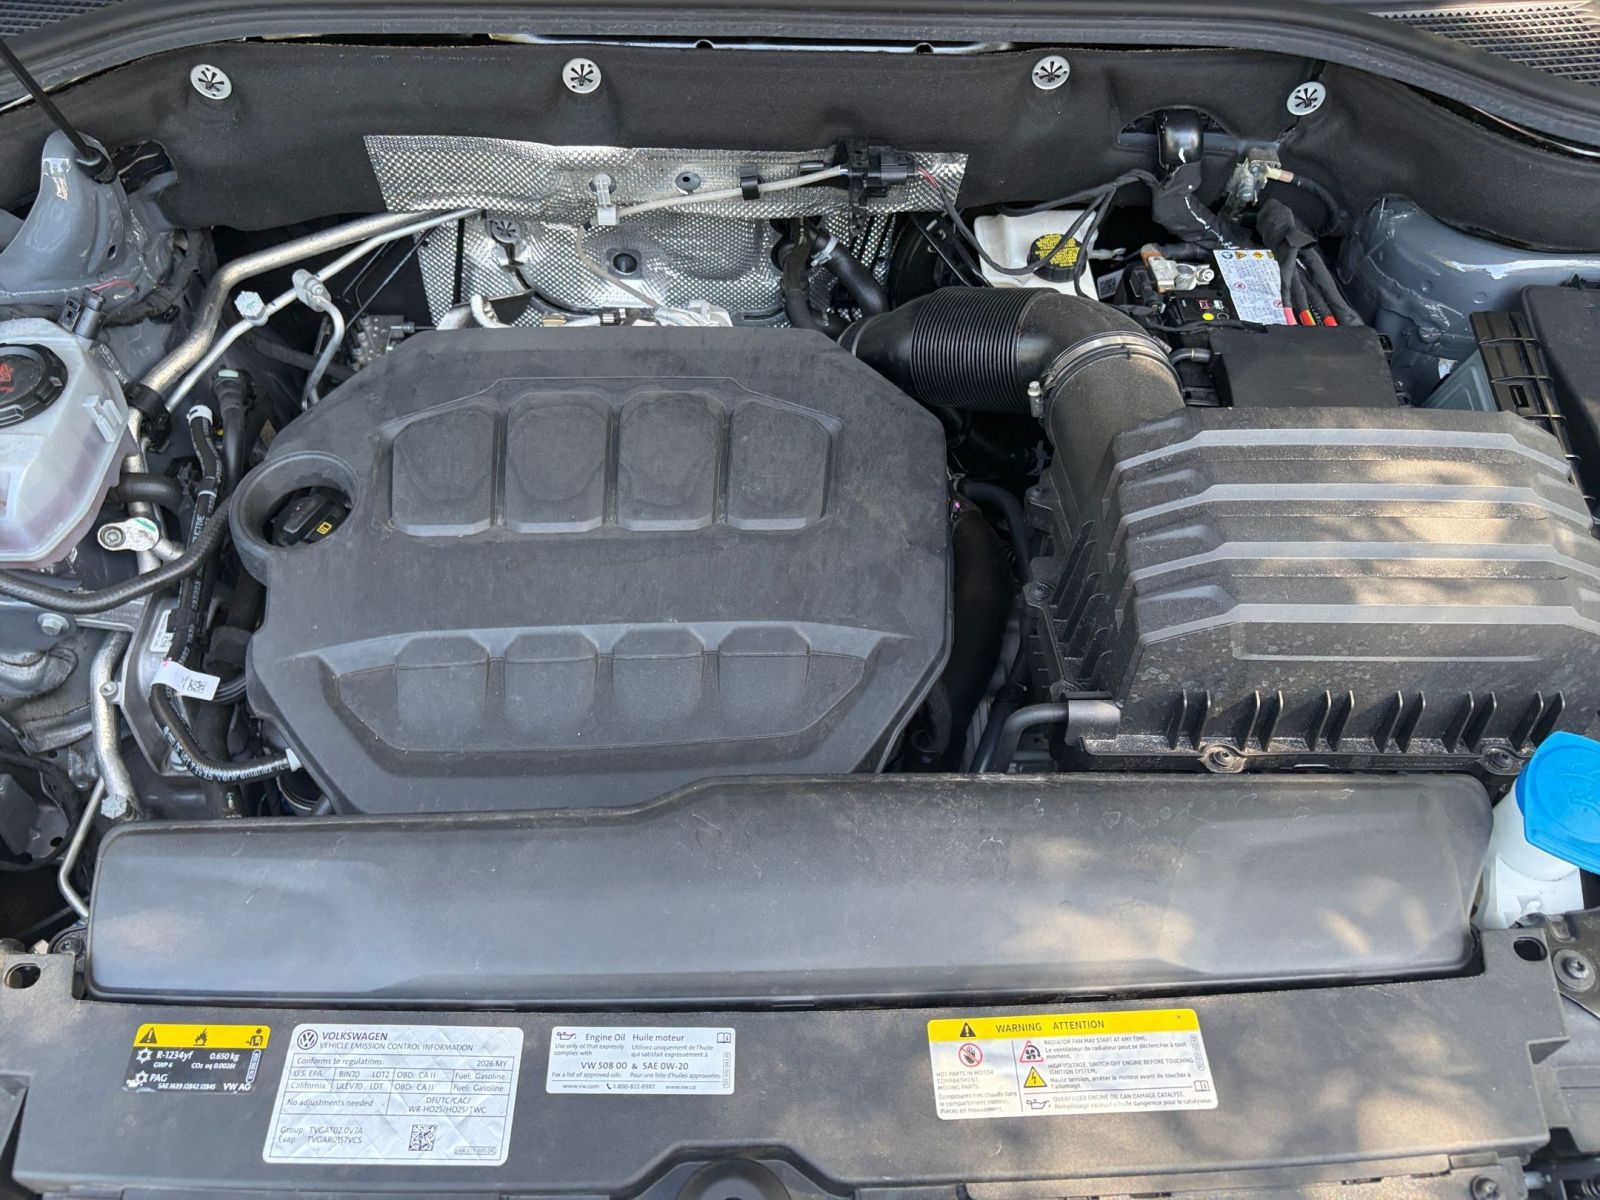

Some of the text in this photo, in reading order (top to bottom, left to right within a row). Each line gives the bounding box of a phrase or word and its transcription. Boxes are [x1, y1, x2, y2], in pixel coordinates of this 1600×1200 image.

[996, 1019, 1105, 1033] WARNING ATTENTION
[322, 1032, 388, 1040] VOLKSWAGEN
[585, 1033, 626, 1043] Engine Oil
[632, 1033, 685, 1042] Huile moteur
[422, 1043, 473, 1051] INFORMATION
[156, 1051, 240, 1062] R-1234yf 0.650 kg
[343, 1057, 384, 1066] regulations:
[598, 1062, 614, 1070] 508
[615, 1062, 628, 1070] 00
[642, 1062, 658, 1070] SAE
[660, 1062, 689, 1070] 0W-20
[149, 1073, 168, 1082] PAG
[223, 1083, 252, 1091] VW AG
[299, 1099, 345, 1108] adjustments
